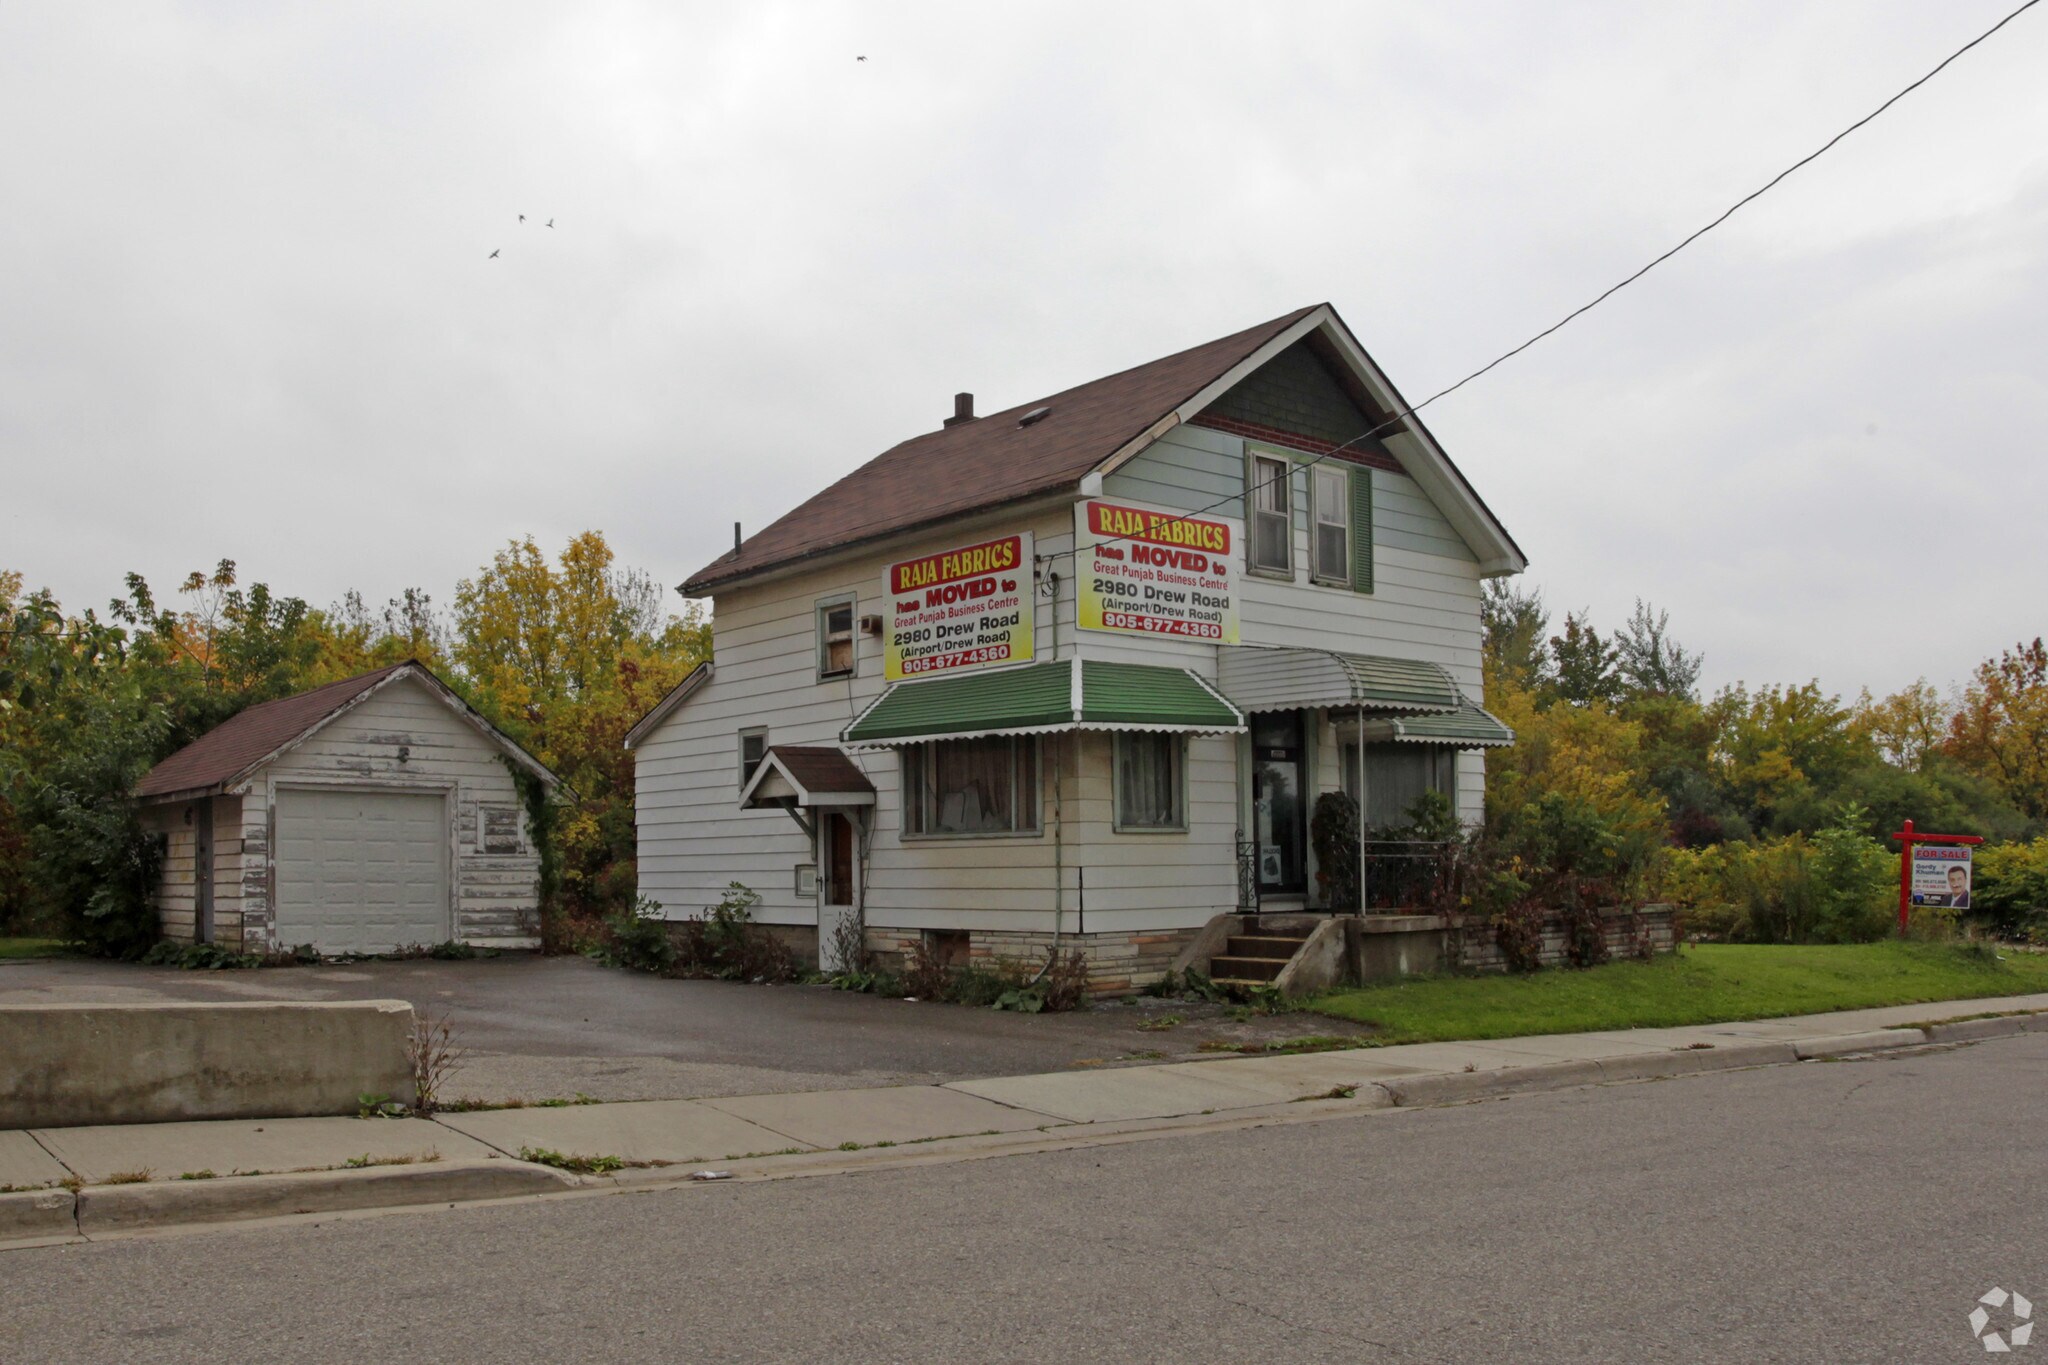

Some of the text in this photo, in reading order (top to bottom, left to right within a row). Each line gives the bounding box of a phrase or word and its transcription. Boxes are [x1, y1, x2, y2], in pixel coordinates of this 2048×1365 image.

[1099, 508, 1223, 550] RAJA FABRICS
[900, 541, 1013, 589] RAJA FABRICS
[1095, 543, 1226, 575] has MOVED to
[1094, 561, 1228, 590] Great Punjab Business Centre
[896, 578, 1016, 614] has MOVED to
[1093, 579, 1229, 609] 2980 Drew Road
[895, 597, 1019, 628] Great Punjab Business Centre
[1102, 598, 1222, 623] (Airport/Drew Road)
[894, 612, 1019, 645] 2980 Drew Road
[1105, 615, 1219, 637] 905-677-4360
[901, 631, 1010, 660] (Airport/Drew Road)
[904, 646, 1008, 673] 905-677-4360
[1941, 850, 1967, 859] SALE
